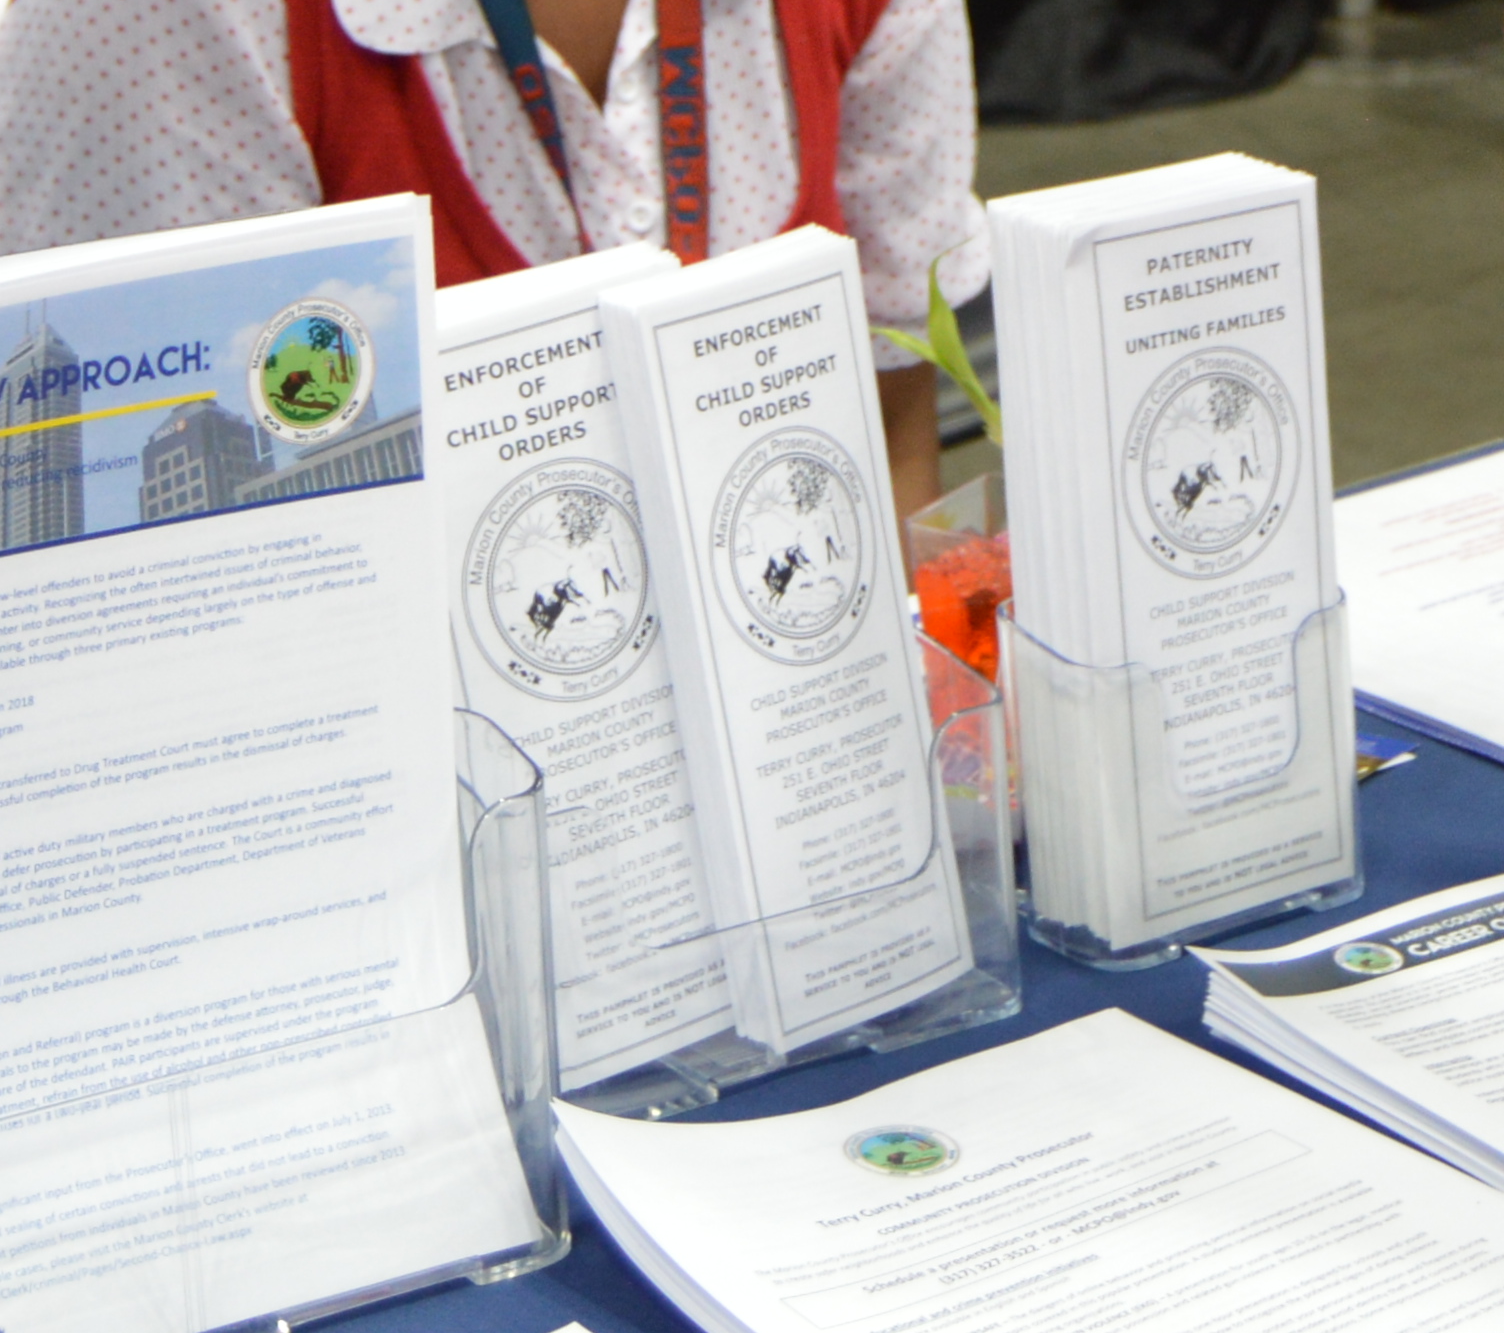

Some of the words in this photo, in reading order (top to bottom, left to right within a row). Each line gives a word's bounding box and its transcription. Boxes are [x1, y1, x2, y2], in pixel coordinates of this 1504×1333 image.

[1147, 239, 1253, 275] PATERNITY
[1125, 263, 1281, 312] ESTABLISHMENT
[693, 305, 822, 357] ENFORCEMENT
[1126, 325, 1201, 354] UNITING
[1207, 306, 1285, 337] FAMILIES
[17, 341, 211, 406] APPROACH:
[444, 330, 604, 393] ENFORCEMENT
[756, 346, 777, 366] OF
[519, 374, 547, 398] OF
[696, 379, 756, 411] CHILD
[762, 356, 836, 392] SUPPORT
[447, 410, 518, 449] CHILD
[739, 393, 811, 426] ORDERS
[1127, 406, 1152, 462] Marion
[1150, 366, 1192, 406] County
[1195, 358, 1267, 387] Prosecutor's
[1268, 382, 1290, 426] Office
[499, 421, 586, 461] ORDERS
[1, 468, 63, 494] reducing
[66, 453, 138, 480] recidivism
[716, 492, 735, 549] Marion
[732, 452, 769, 490] County
[771, 437, 842, 467] Prosecutor's
[839, 464, 862, 505] Office
[470, 526, 494, 588] Marion
[491, 481, 534, 525] County
[537, 468, 622, 496] Prosecutor's
[1150, 601, 1185, 619] CHILD
[1189, 585, 1239, 609] SUPPORT
[1243, 570, 1294, 594] DIVISION
[1178, 607, 1221, 627] MARION
[1226, 594, 1271, 615] COUNTY
[1162, 617, 1246, 650] PROSECUTOR'S
[1250, 606, 1288, 626] OFFICE
[562, 677, 589, 695] Terry
[590, 665, 619, 690] Curry
[751, 689, 786, 711] CHILD
[790, 670, 839, 698] SUPPORT
[843, 652, 887, 680] DIVISION
[781, 695, 825, 720] MARION
[829, 678, 869, 703] COUNTY
[7, 696, 34, 710] 2018
[559, 704, 616, 735] SUPPORT
[767, 704, 850, 743] PROSECUTOR'S
[853, 689, 887, 713] OFFICE
[548, 730, 599, 757] MARION
[605, 710, 654, 738] COUNTY
[634, 720, 676, 747] OFFICE
[756, 756, 791, 778] TERRY
[841, 713, 903, 747] PROSECUTOR
[821, 754, 849, 774] OHIO
[853, 738, 888, 762] STREET
[565, 778, 614, 802] CURRY,
[595, 789, 628, 811] OHIO
[634, 770, 678, 797] STREET
[797, 773, 847, 802] SEVENTH
[851, 759, 882, 781] FLOOR
[630, 794, 669, 818] FLOOR
[1407, 922, 1489, 957] CAREER
[815, 1212, 859, 1231] Terry
[907, 1177, 962, 1204] Marion
[963, 1162, 1014, 1187] County
[1017, 1131, 1094, 1164] Prosecutor
